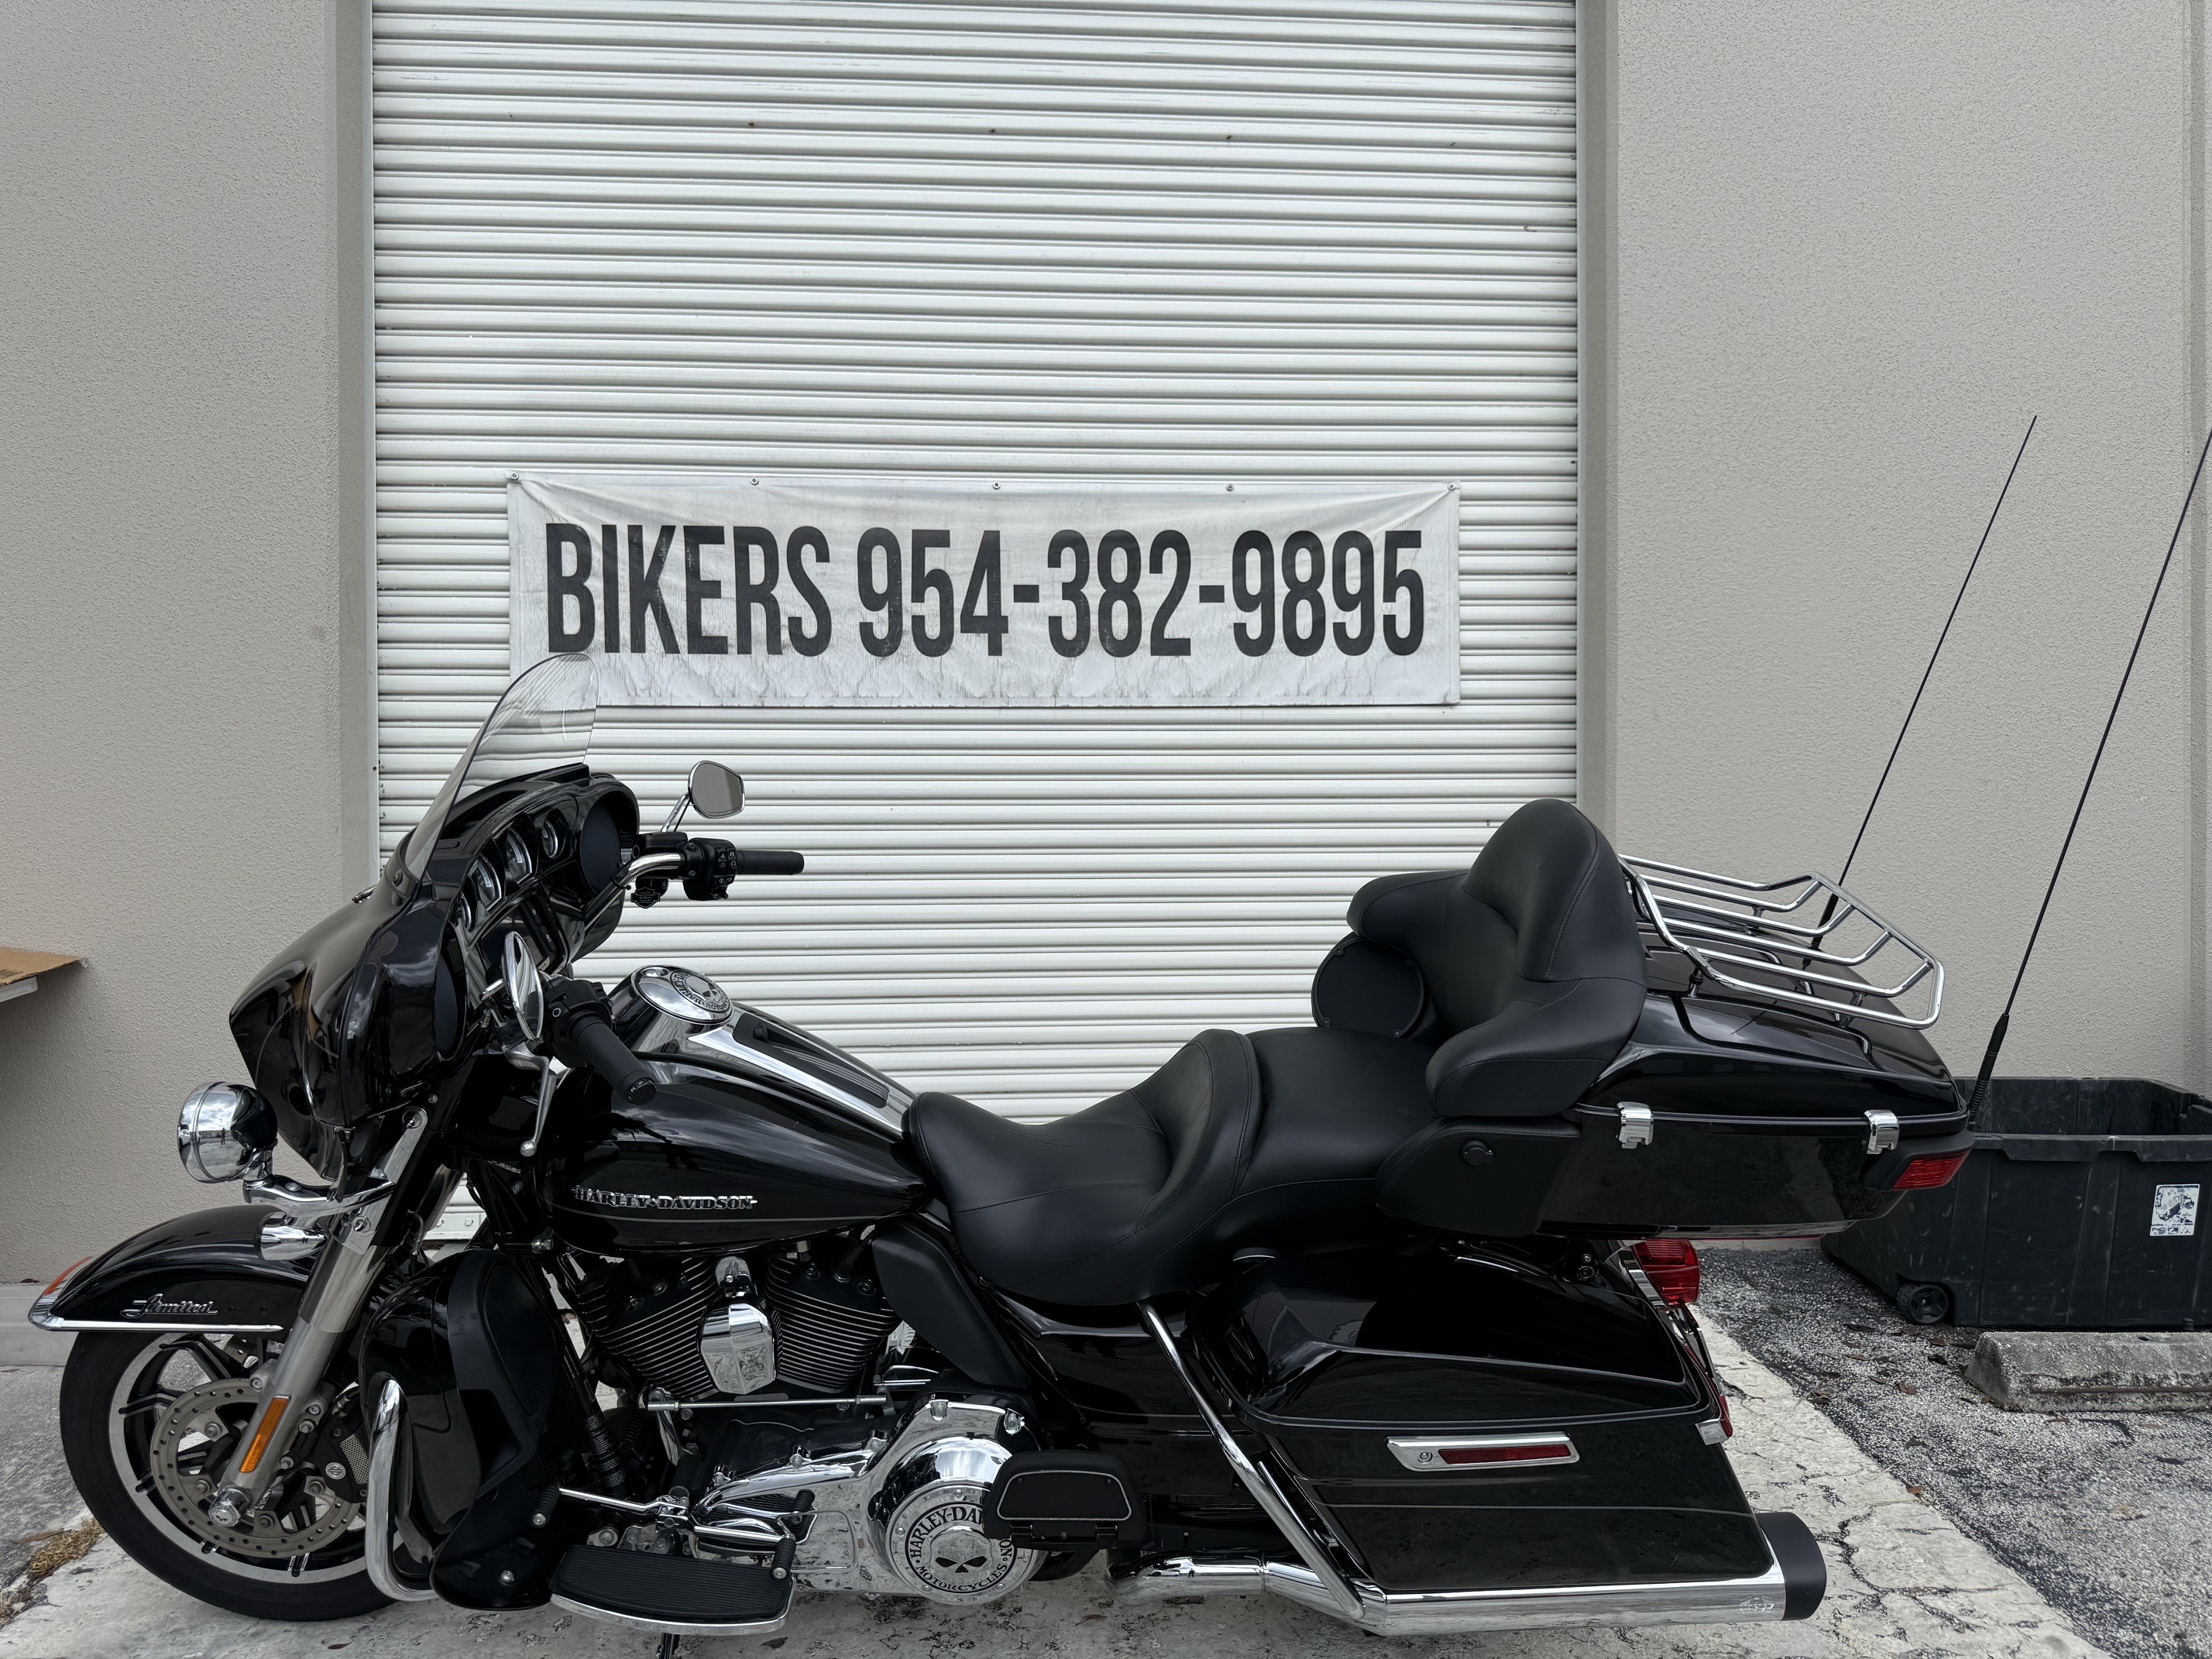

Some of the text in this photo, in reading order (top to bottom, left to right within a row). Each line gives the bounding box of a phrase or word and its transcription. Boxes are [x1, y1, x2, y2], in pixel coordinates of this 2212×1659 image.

[545, 524, 1425, 658] BIKERS 954-382-9895
[120, 1293, 219, 1319] Limited
[909, 1506, 1013, 1558] HARLEY-DAON
[915, 1563, 1008, 1591] MOTORCYCLES
